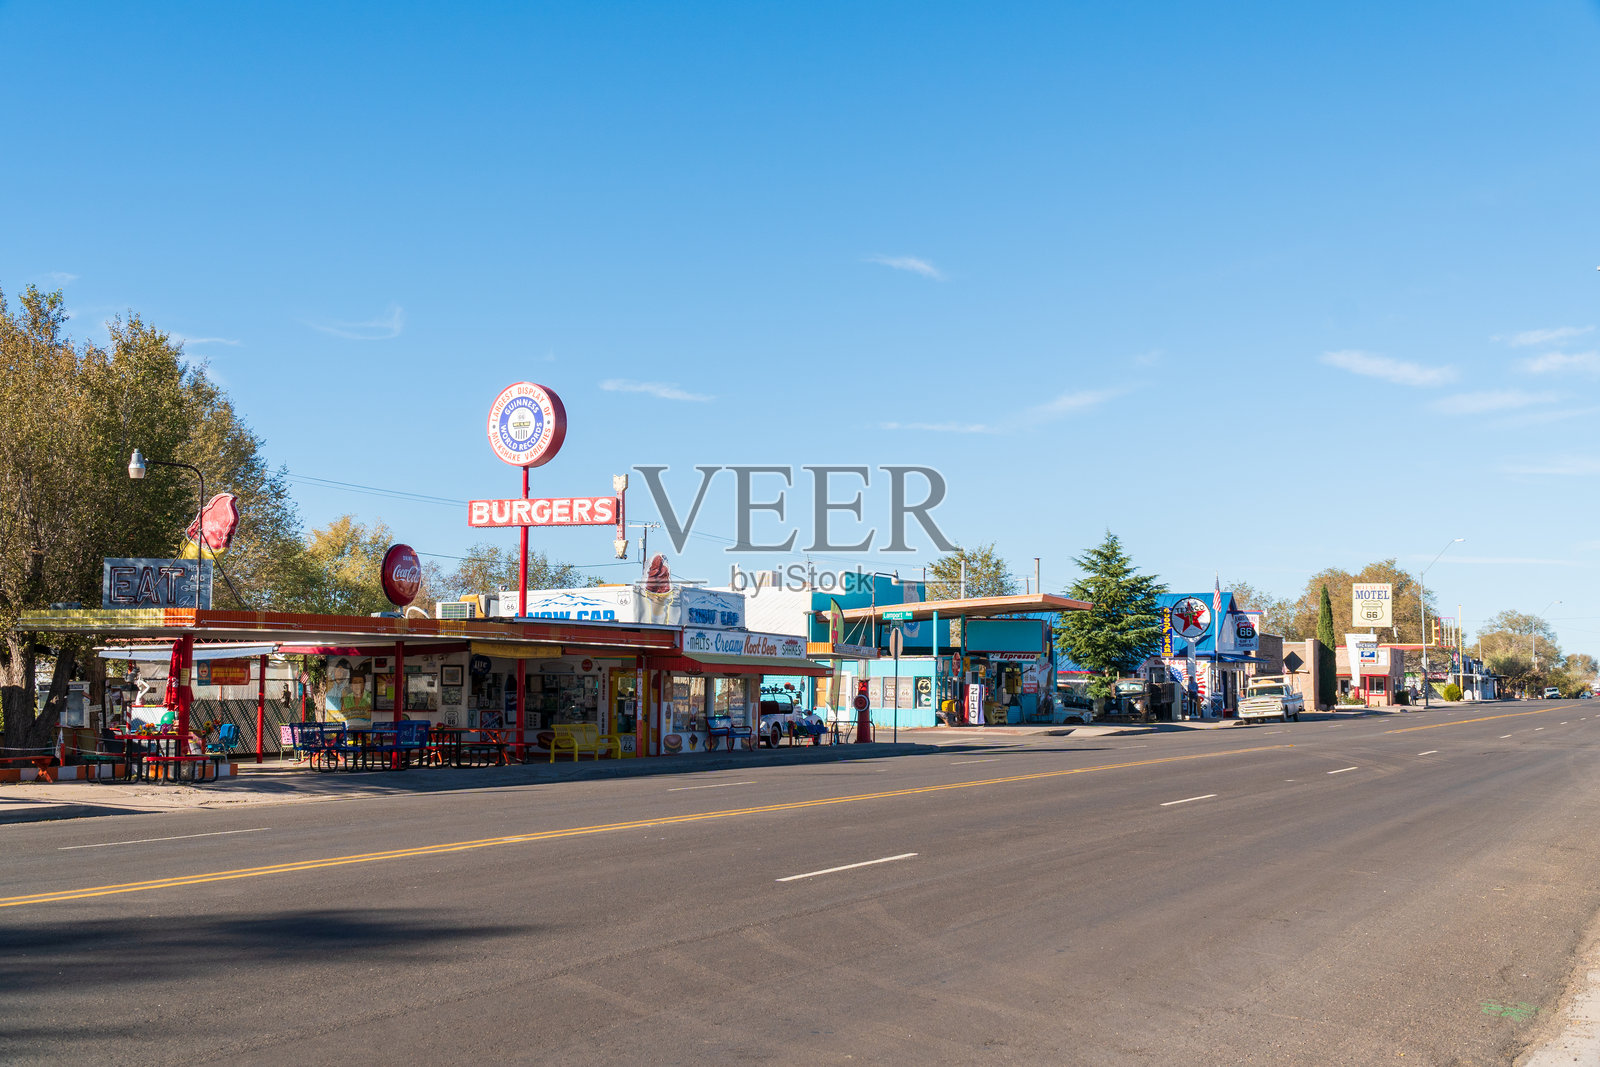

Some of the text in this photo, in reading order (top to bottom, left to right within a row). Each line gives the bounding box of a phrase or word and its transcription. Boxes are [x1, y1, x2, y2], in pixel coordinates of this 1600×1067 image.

[492, 386, 552, 422] LARGEST DISPLAY OF
[504, 398, 539, 415] GUINNESS
[491, 427, 551, 462] MILKSHAKE VARIETIES
[500, 422, 543, 451] WORLD RECORDS
[471, 498, 613, 525] BURGERS
[110, 566, 185, 604] EAT
[1355, 590, 1390, 600] MOTEL
[1176, 604, 1205, 613] TEXACO
[1240, 628, 1252, 636] 66
[689, 632, 801, 656] MALTS Creamy Root Beer SHAKES
[999, 652, 1036, 661] Espresso
[919, 681, 930, 690] 66
[969, 687, 978, 719] OPEN
[623, 742, 633, 751] 66
